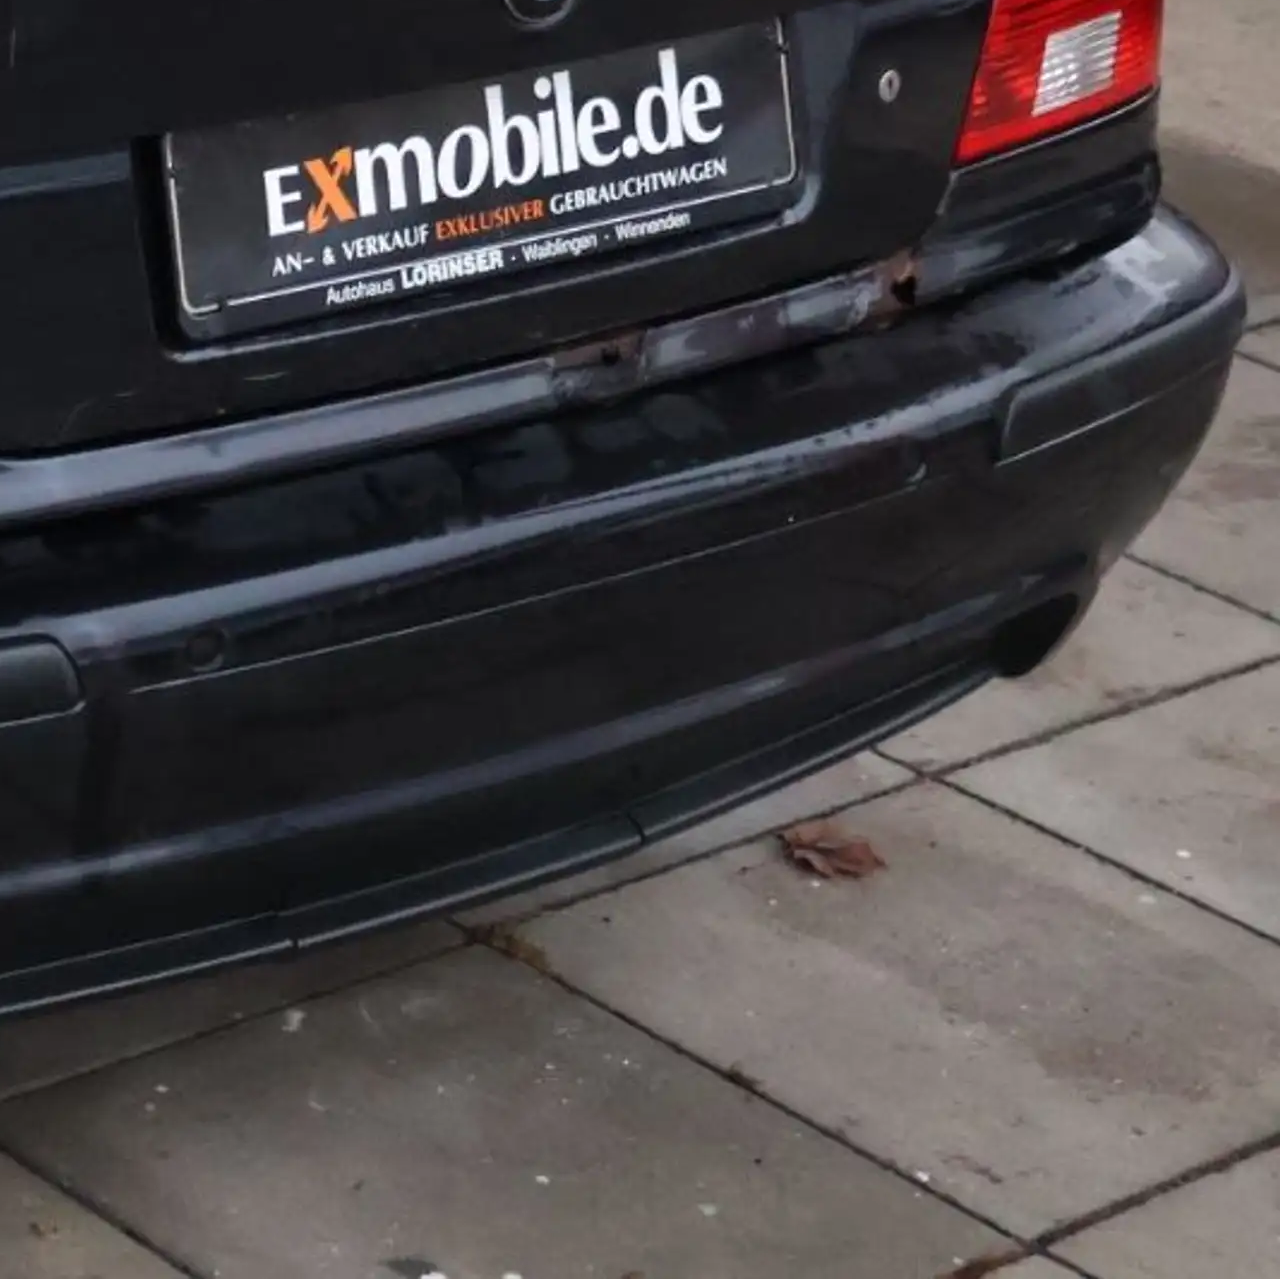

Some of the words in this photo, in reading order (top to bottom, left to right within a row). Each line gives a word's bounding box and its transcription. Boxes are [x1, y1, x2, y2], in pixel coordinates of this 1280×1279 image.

[272, 251, 315, 278] AN-
[322, 246, 336, 266] &
[342, 224, 430, 261] VERKAUF
[435, 198, 545, 240] EXKLUSIVER
[549, 157, 728, 215] GEBRAUCHTWAGEN
[326, 277, 395, 306] Autohaus
[400, 248, 505, 290] LORINSER
[521, 233, 598, 264] Waiblingen
[614, 211, 692, 241] Winnenden
